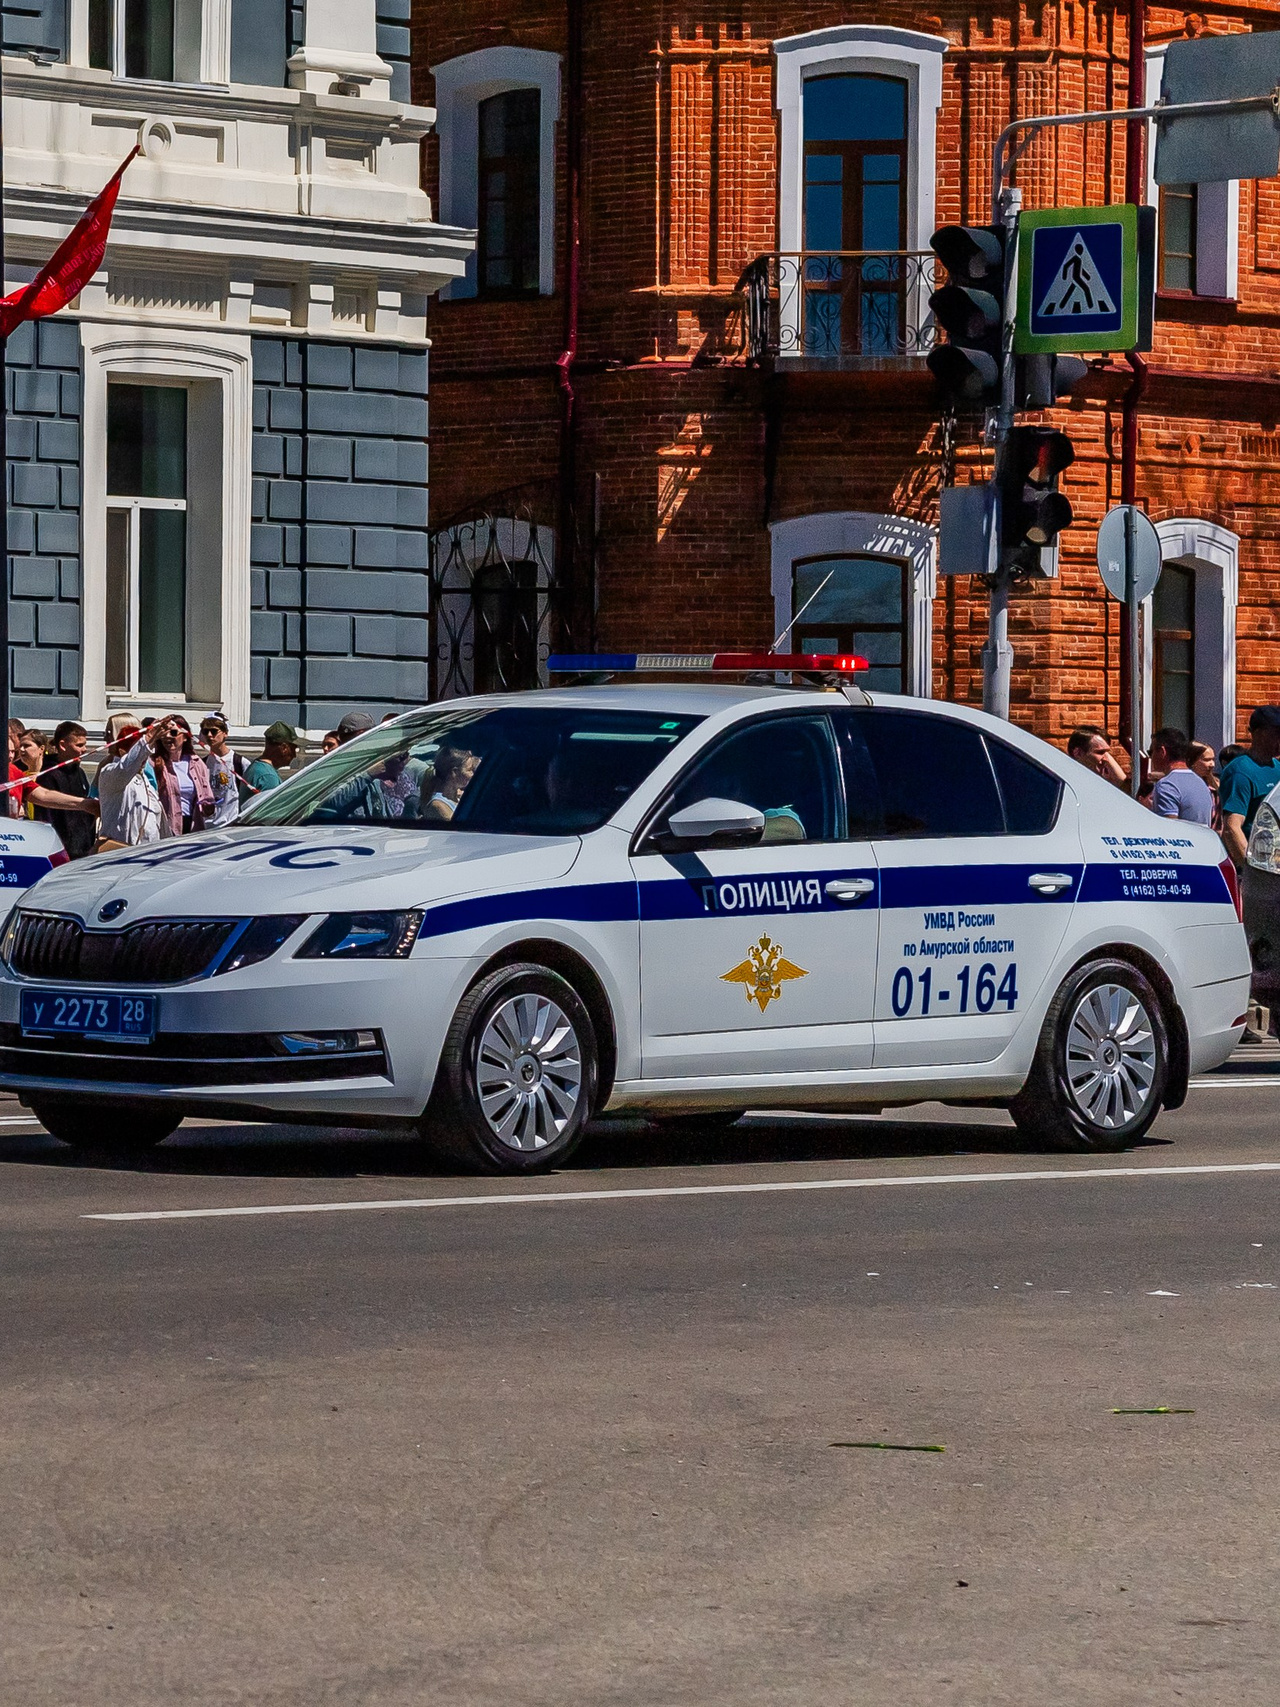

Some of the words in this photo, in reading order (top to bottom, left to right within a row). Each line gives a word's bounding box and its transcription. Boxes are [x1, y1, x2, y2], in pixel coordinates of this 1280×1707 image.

[1101, 836, 1122, 846] ТЕЛ.
[1166, 838, 1194, 848] ЧАСТИ
[1110, 849, 1118, 859] 8
[1118, 849, 1146, 860] (4162)
[1119, 869, 1139, 880] ТЕЛ.
[1140, 869, 1178, 882] ДОВЕРИЯ
[701, 878, 823, 912] ПОЛИЦИЯ
[1122, 885, 1130, 896] 8
[1130, 885, 1156, 898] (4162)
[1157, 884, 1192, 895] 59-40-59
[923, 911, 956, 932] УМВД
[957, 911, 996, 928] России
[903, 943, 917, 957] по
[919, 937, 970, 959] Амурской
[972, 936, 1015, 954] области
[891, 962, 1019, 1018] 01-164
[53, 997, 109, 1028] 2273
[122, 1000, 145, 1022] 28
